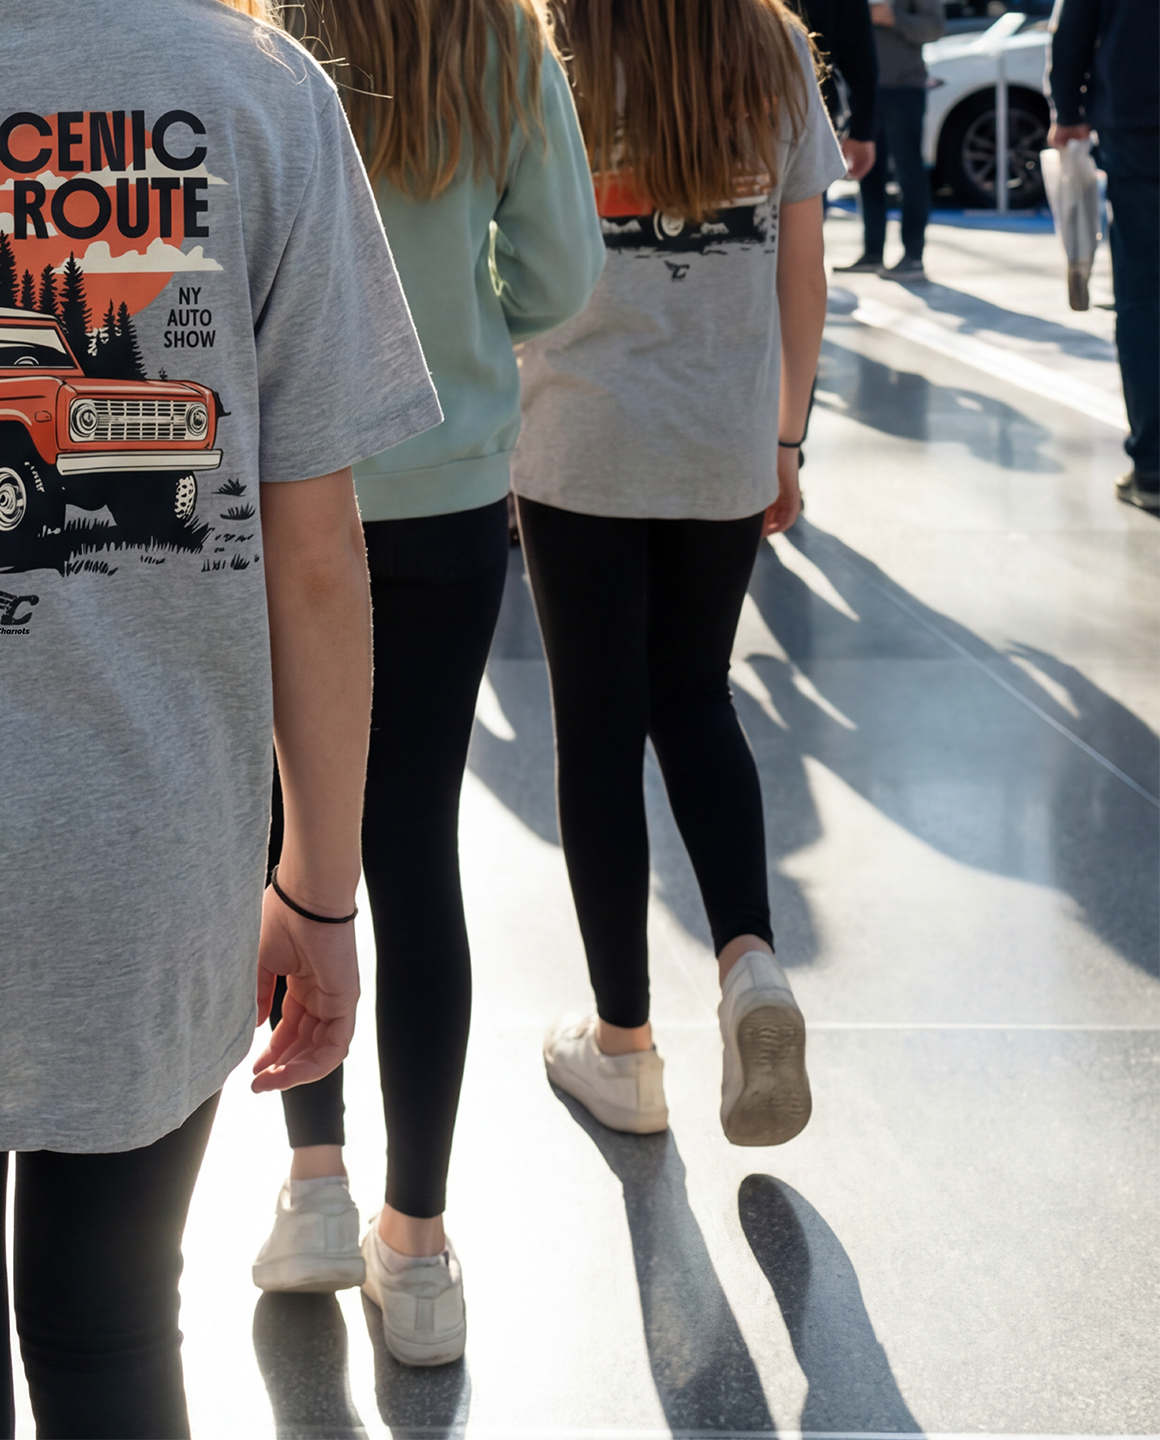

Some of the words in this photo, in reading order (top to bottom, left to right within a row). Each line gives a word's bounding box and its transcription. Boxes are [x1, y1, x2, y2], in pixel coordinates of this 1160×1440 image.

[13, 177, 210, 240] ROUTE
[178, 286, 202, 305] NY
[166, 309, 212, 327] AUTO
[163, 330, 216, 348] SHOW
